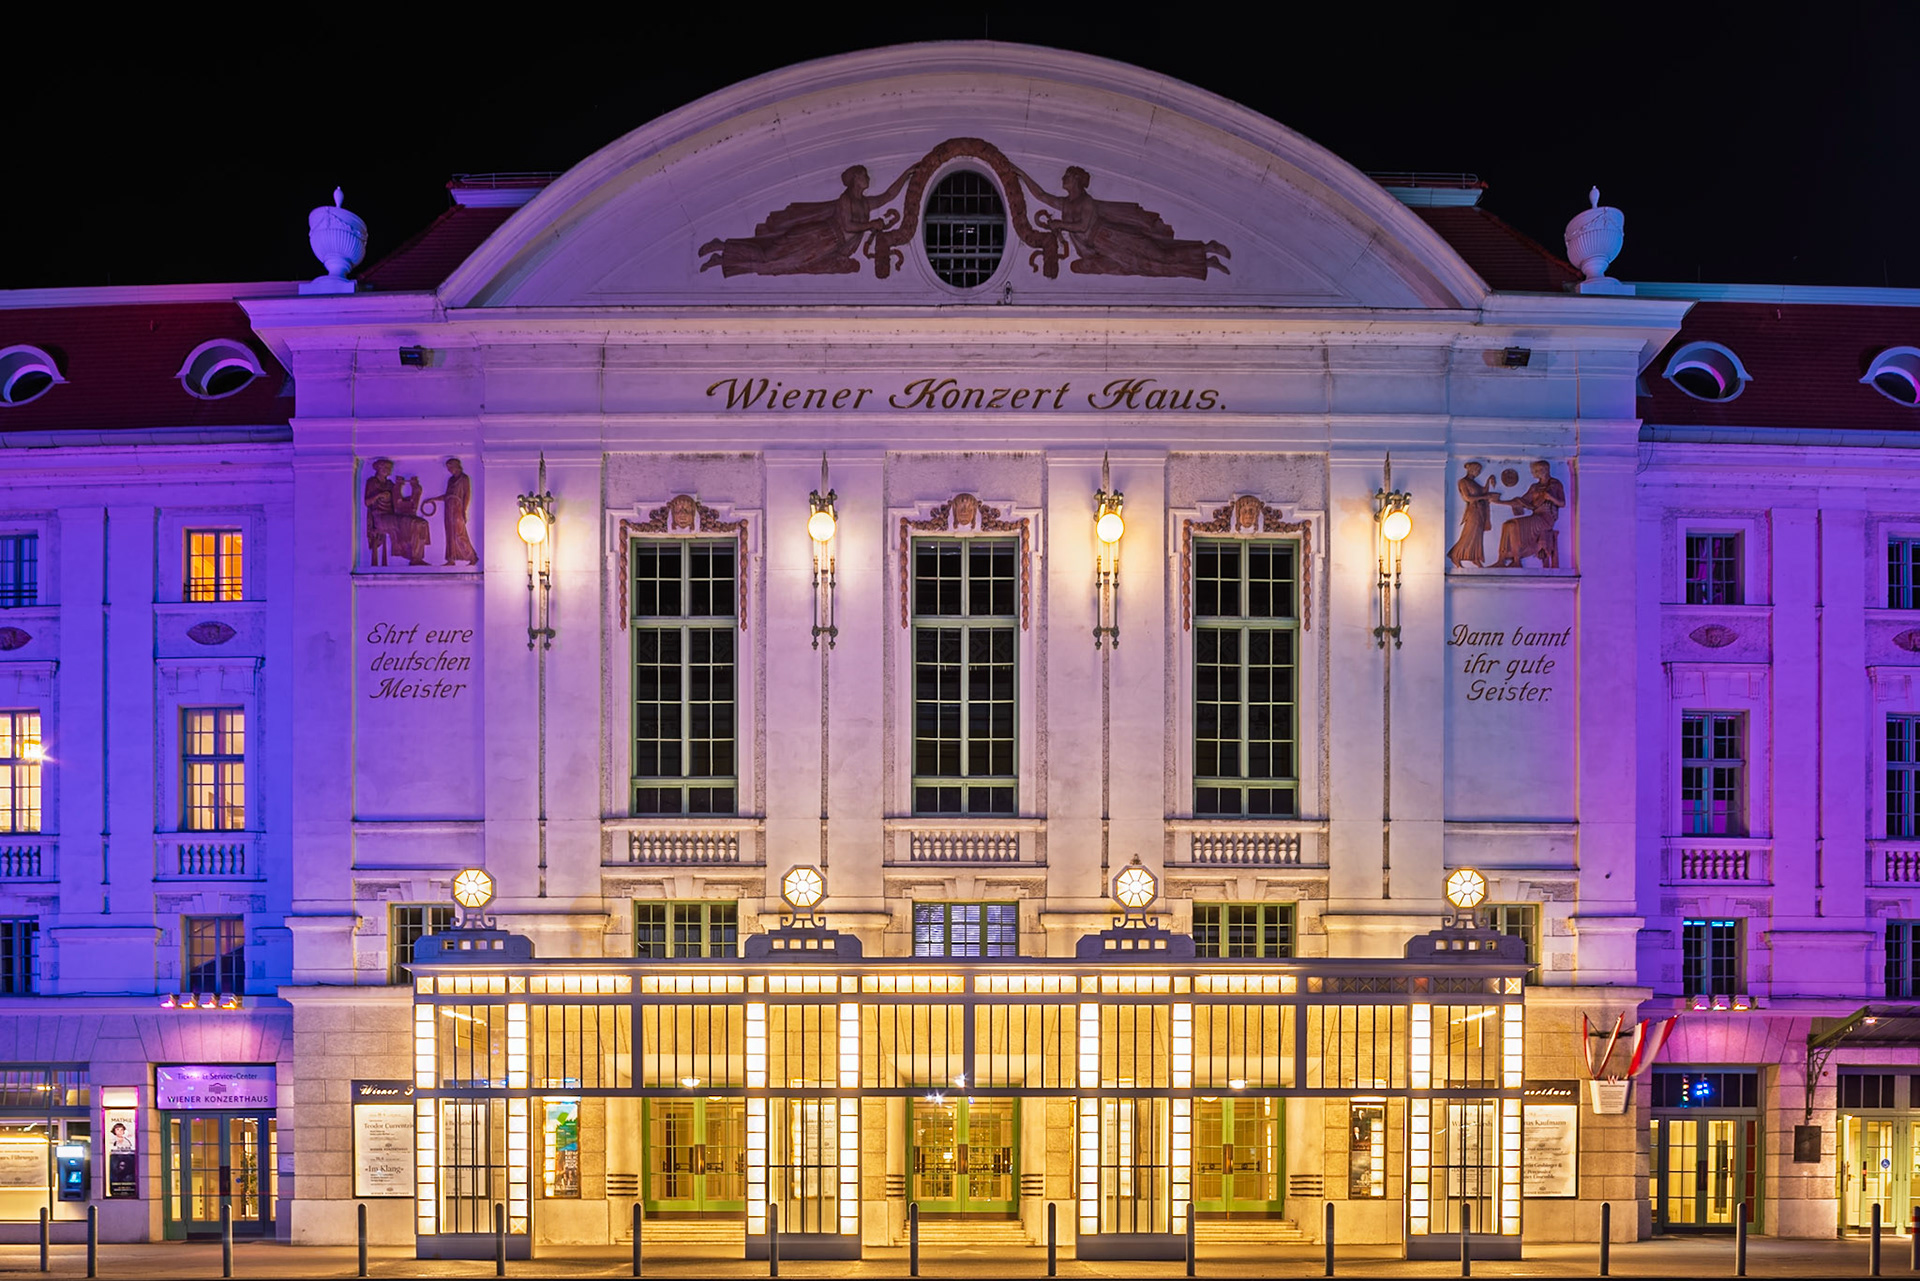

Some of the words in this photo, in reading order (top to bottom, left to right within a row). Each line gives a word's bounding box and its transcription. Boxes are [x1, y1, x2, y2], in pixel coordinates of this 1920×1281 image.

[706, 376, 873, 411] Wiener
[888, 376, 1070, 411] Konzert
[1087, 376, 1228, 411] Haus.
[367, 622, 420, 645] Ehrt
[425, 629, 474, 645] eure
[1447, 623, 1505, 647] Dann
[1511, 626, 1572, 647] bannt
[370, 650, 471, 672] deutschen
[1463, 652, 1500, 675] ihr
[1504, 654, 1556, 681] gute
[369, 677, 467, 699] Meister
[1466, 679, 1552, 702] Geister.
[209, 1072, 258, 1081] Service-Center
[167, 1095, 201, 1103] WIENER
[204, 1095, 269, 1103] KONZERTHAUS
[359, 1083, 399, 1096] Wiener
